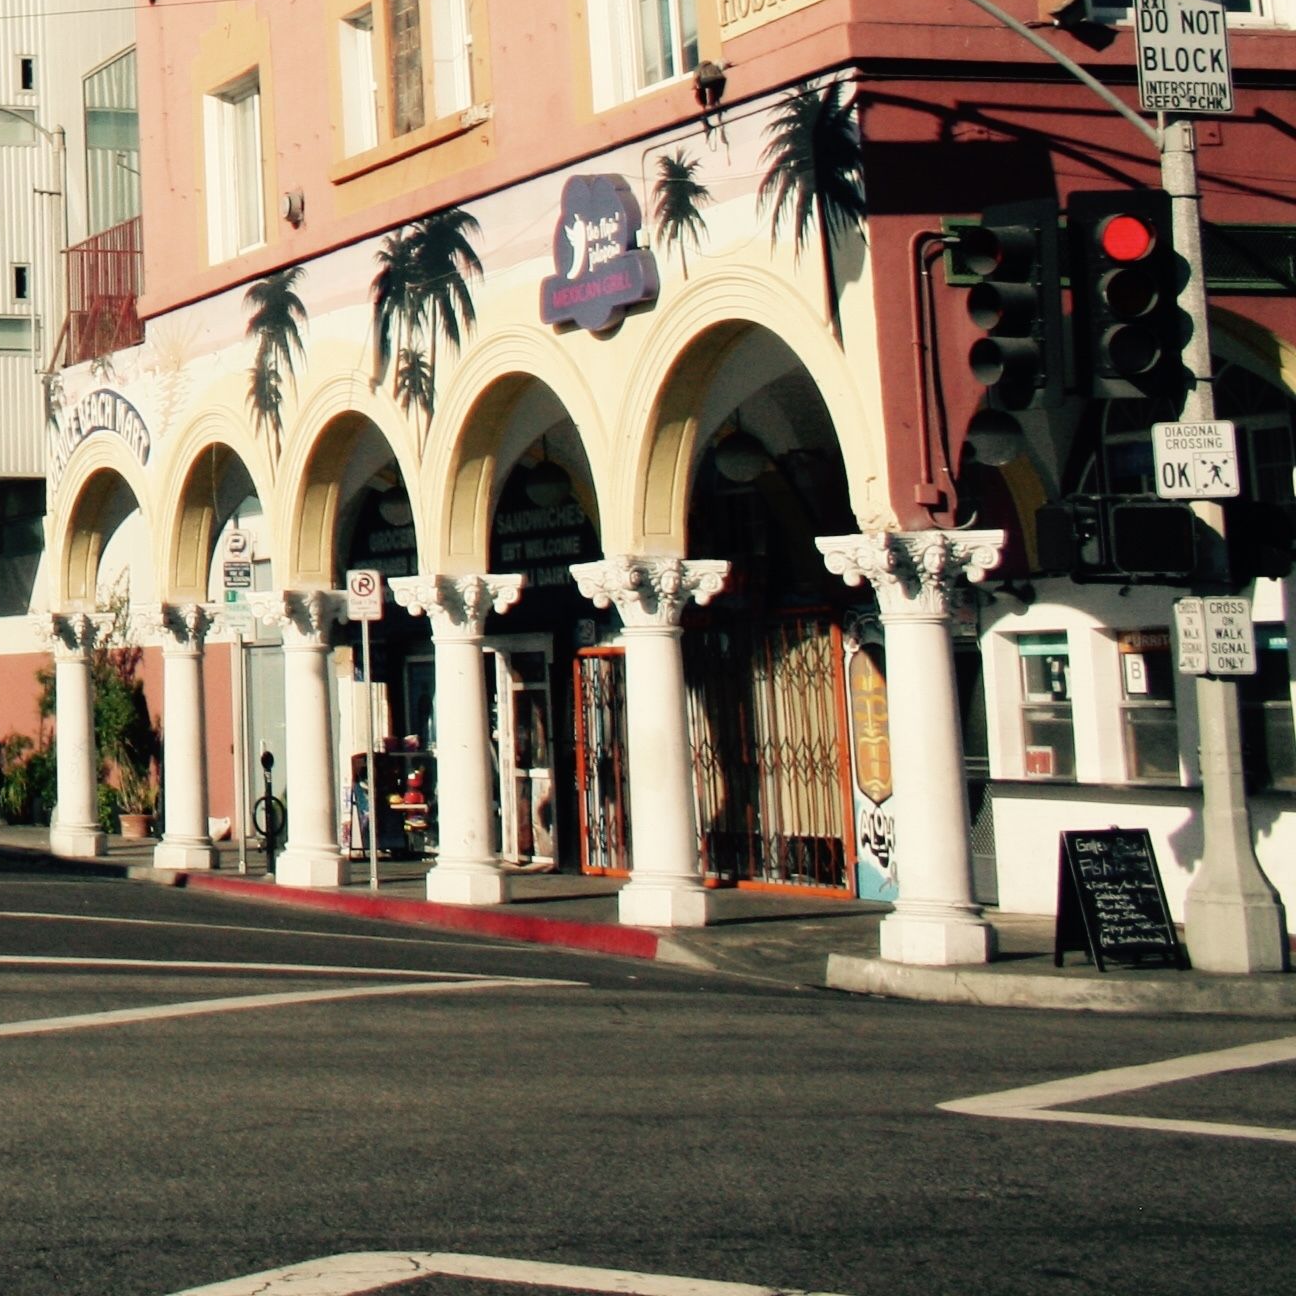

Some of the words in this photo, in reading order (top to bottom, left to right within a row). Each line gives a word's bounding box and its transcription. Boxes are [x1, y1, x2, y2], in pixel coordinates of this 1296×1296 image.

[1140, 10, 1168, 34] DO
[1180, 10, 1220, 35] NOT
[1143, 46, 1225, 73] BLOCK
[1145, 80, 1227, 99] INTERSECTION
[77, 392, 113, 436] BEACH
[115, 397, 151, 466] MART
[1164, 425, 1222, 438] DIAGONAL
[1165, 437, 1224, 450] CROSSING
[1162, 461, 1192, 489] OK
[496, 504, 586, 536] SANDWICHES
[524, 535, 581, 560] WELCOME
[1209, 602, 1245, 615] CROSS
[1221, 616, 1235, 626] ON
[1215, 628, 1245, 640] WALK
[1210, 641, 1250, 654] SIGNAL
[1132, 661, 1143, 680] B
[1217, 655, 1246, 670] ONLY
